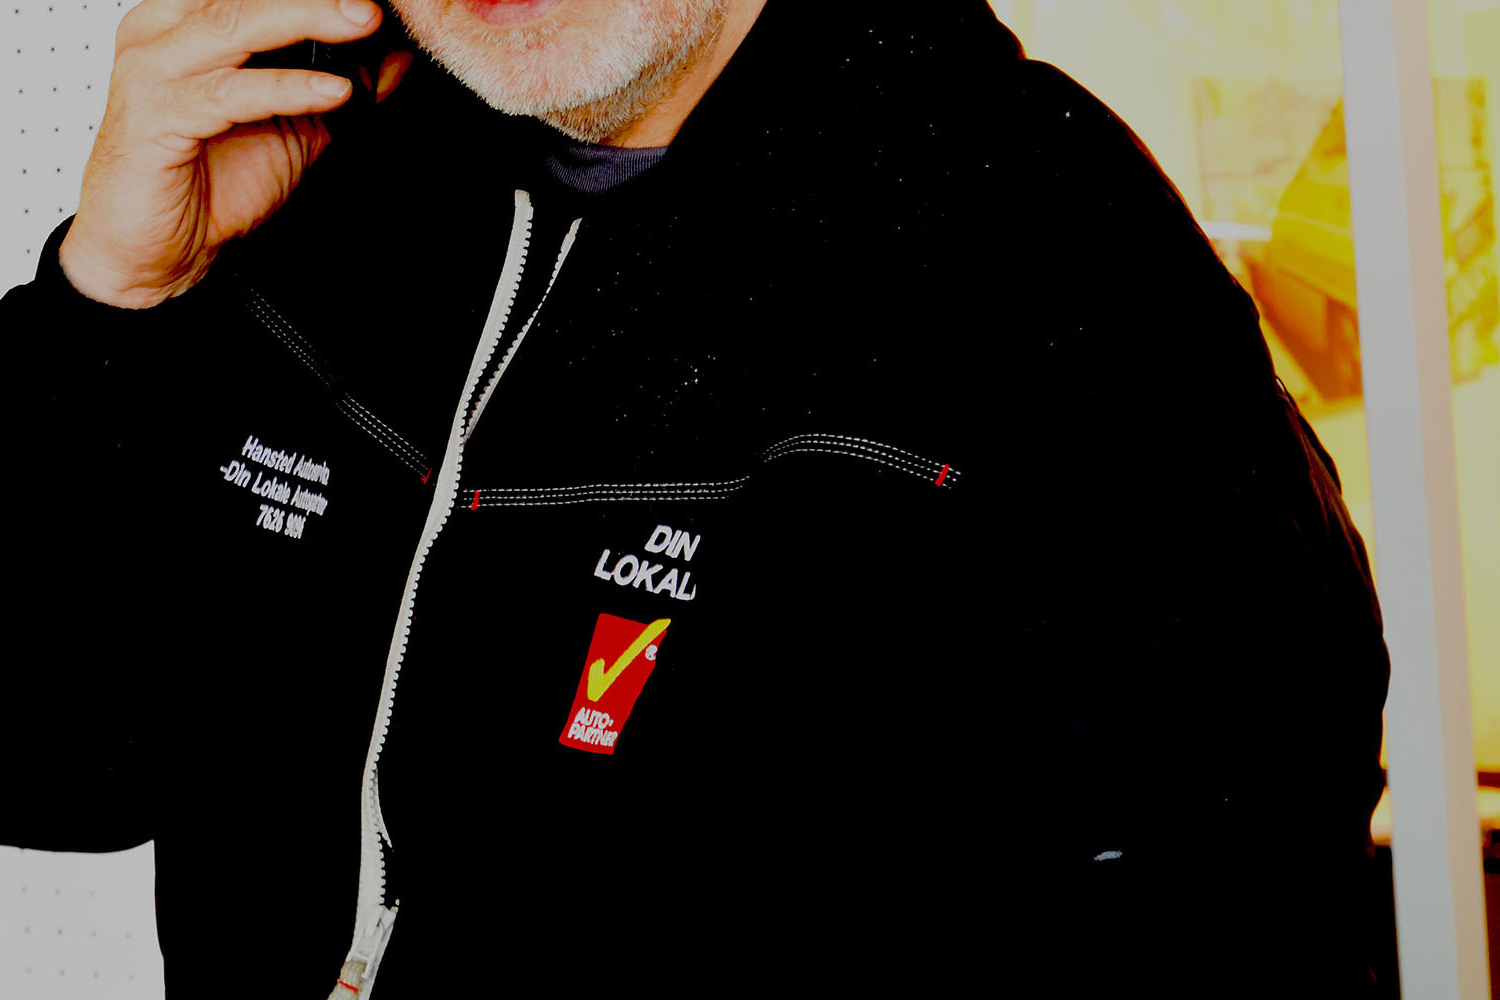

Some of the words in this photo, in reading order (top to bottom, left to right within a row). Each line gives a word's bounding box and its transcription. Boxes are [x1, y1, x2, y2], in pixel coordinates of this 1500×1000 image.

[241, 435, 297, 474] Hansted
[251, 471, 291, 504] Lokale
[256, 504, 285, 533] 7626
[644, 524, 700, 561] DIN
[594, 549, 697, 600] LOKAL
[567, 723, 618, 747] PARTNER
